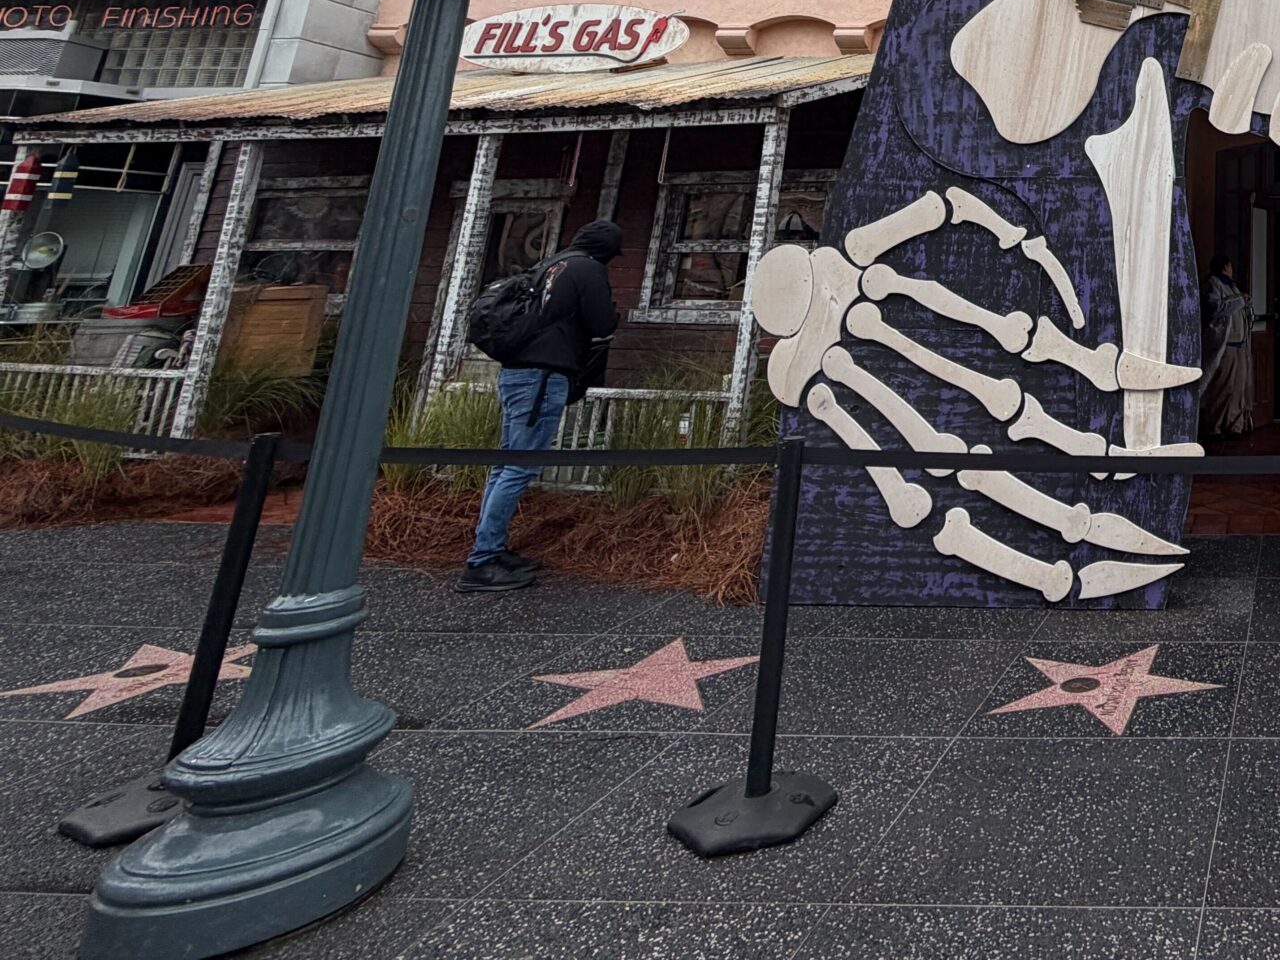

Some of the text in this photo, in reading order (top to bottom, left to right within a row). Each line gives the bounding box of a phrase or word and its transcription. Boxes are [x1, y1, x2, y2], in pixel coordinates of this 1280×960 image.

[0, 3, 256, 29] OTO FINISHING
[473, 13, 646, 55] FILL'S GAS
